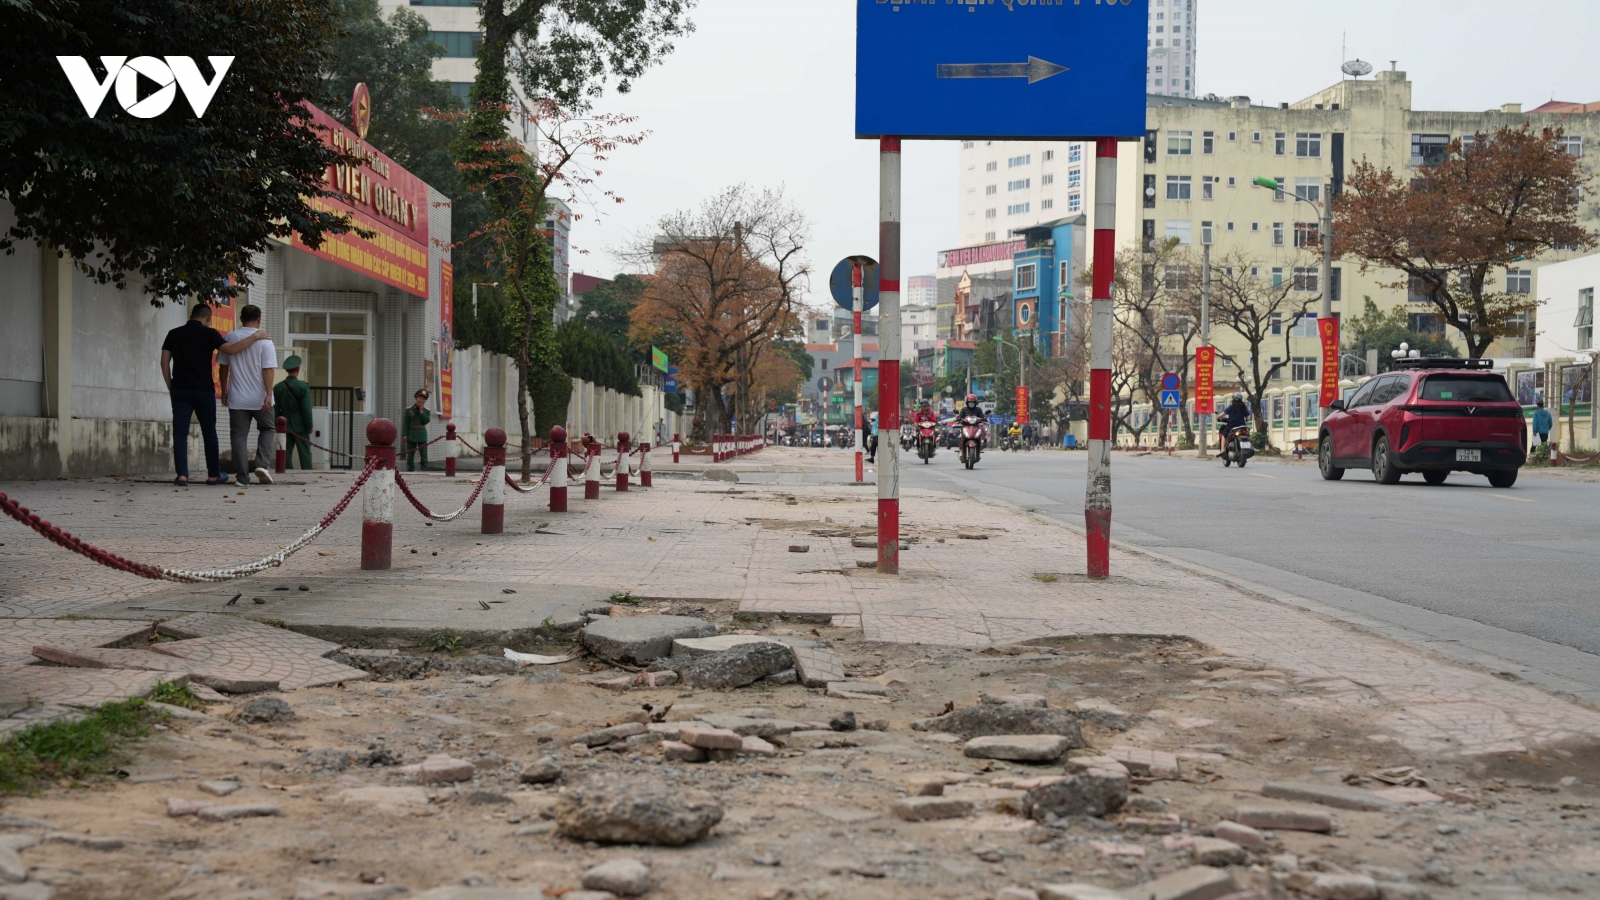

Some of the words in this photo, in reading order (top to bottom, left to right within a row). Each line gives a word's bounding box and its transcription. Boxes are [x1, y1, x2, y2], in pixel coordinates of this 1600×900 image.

[333, 127, 344, 152] BỘ
[336, 163, 371, 206] VIỆN
[375, 182, 408, 228] QUÂN
[411, 204, 418, 231] Y
[980, 245, 993, 263] KHOA
